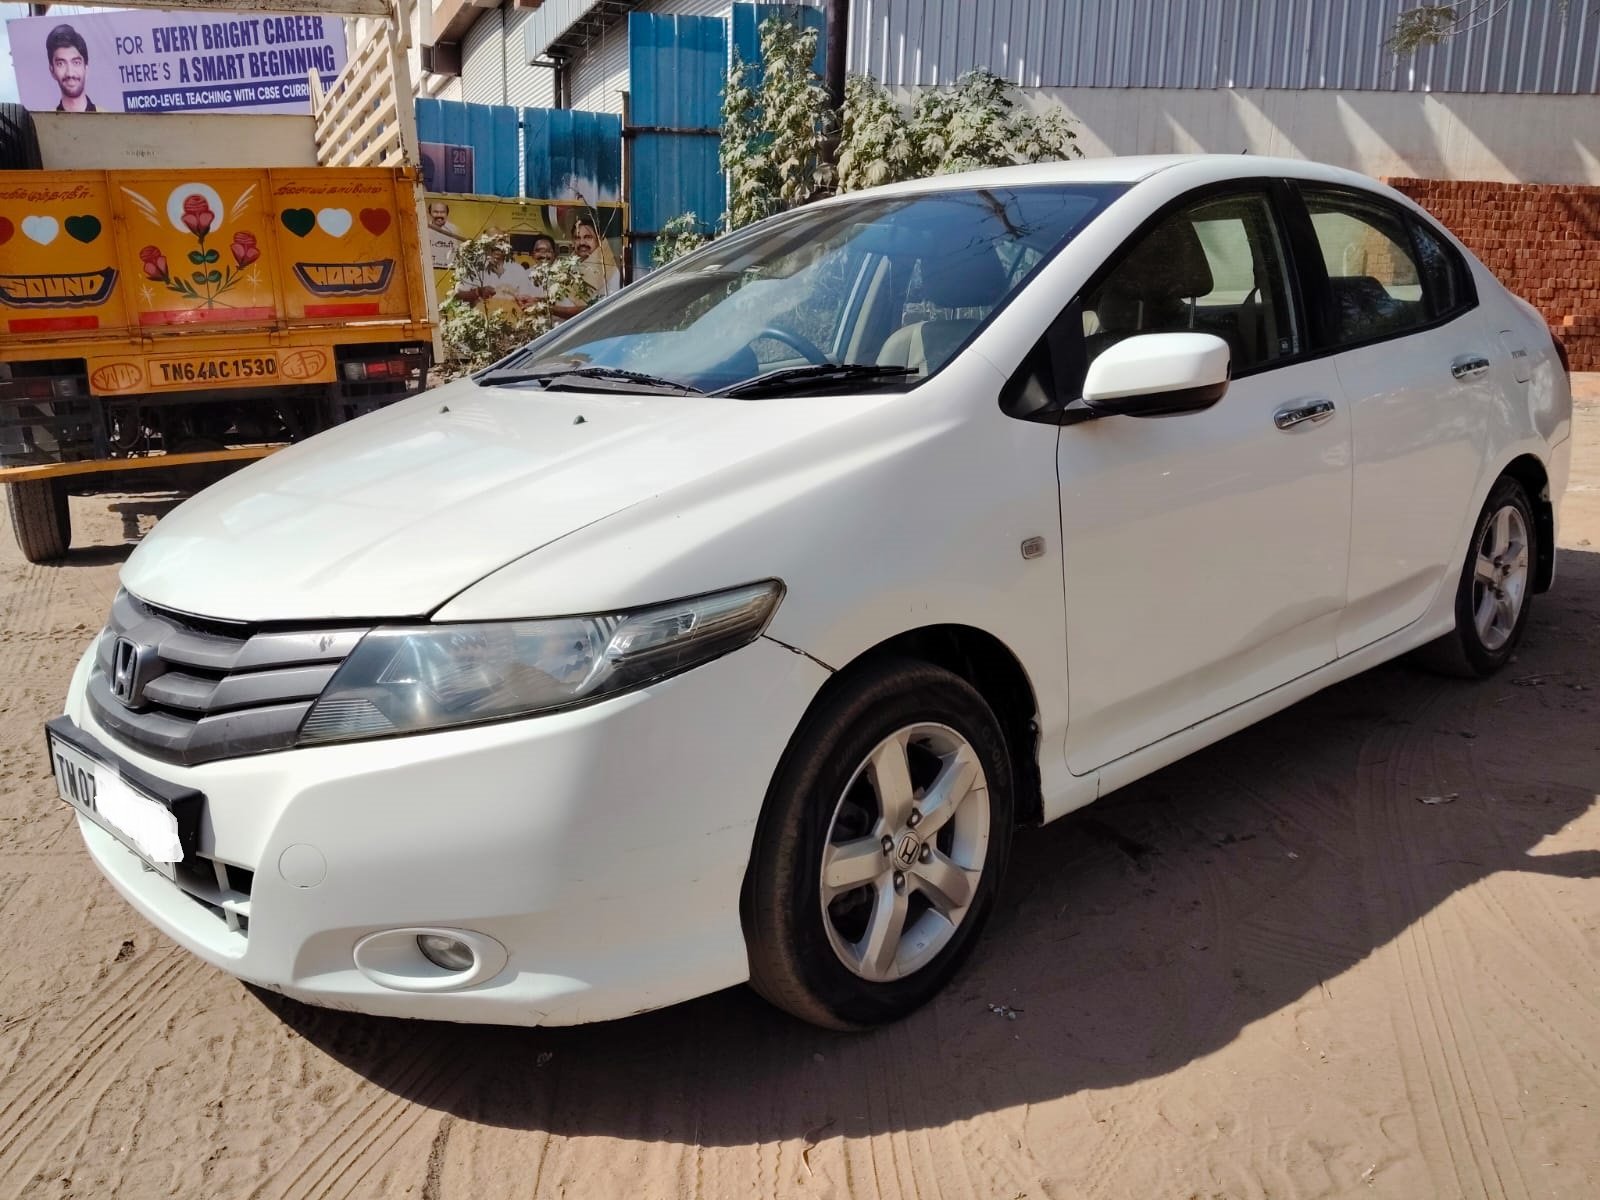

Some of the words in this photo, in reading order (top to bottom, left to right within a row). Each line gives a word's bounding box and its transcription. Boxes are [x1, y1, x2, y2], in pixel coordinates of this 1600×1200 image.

[115, 35, 143, 55] FOR
[152, 25, 197, 53] EVERY
[201, 20, 259, 50] BRIGHT
[263, 15, 324, 45] CAREER
[119, 61, 171, 84] THERE'S
[179, 57, 191, 83] A
[191, 53, 245, 82] SMART
[248, 44, 336, 78] BEGINNING
[127, 93, 185, 109] MICRO-LEVEL
[186, 89, 232, 105] TEACHING
[234, 87, 255, 101] WITH
[257, 85, 281, 99] CBSE
[3, 275, 104, 298] SOUND
[303, 265, 384, 286] HORN
[160, 358, 277, 382] TN64AC1530
